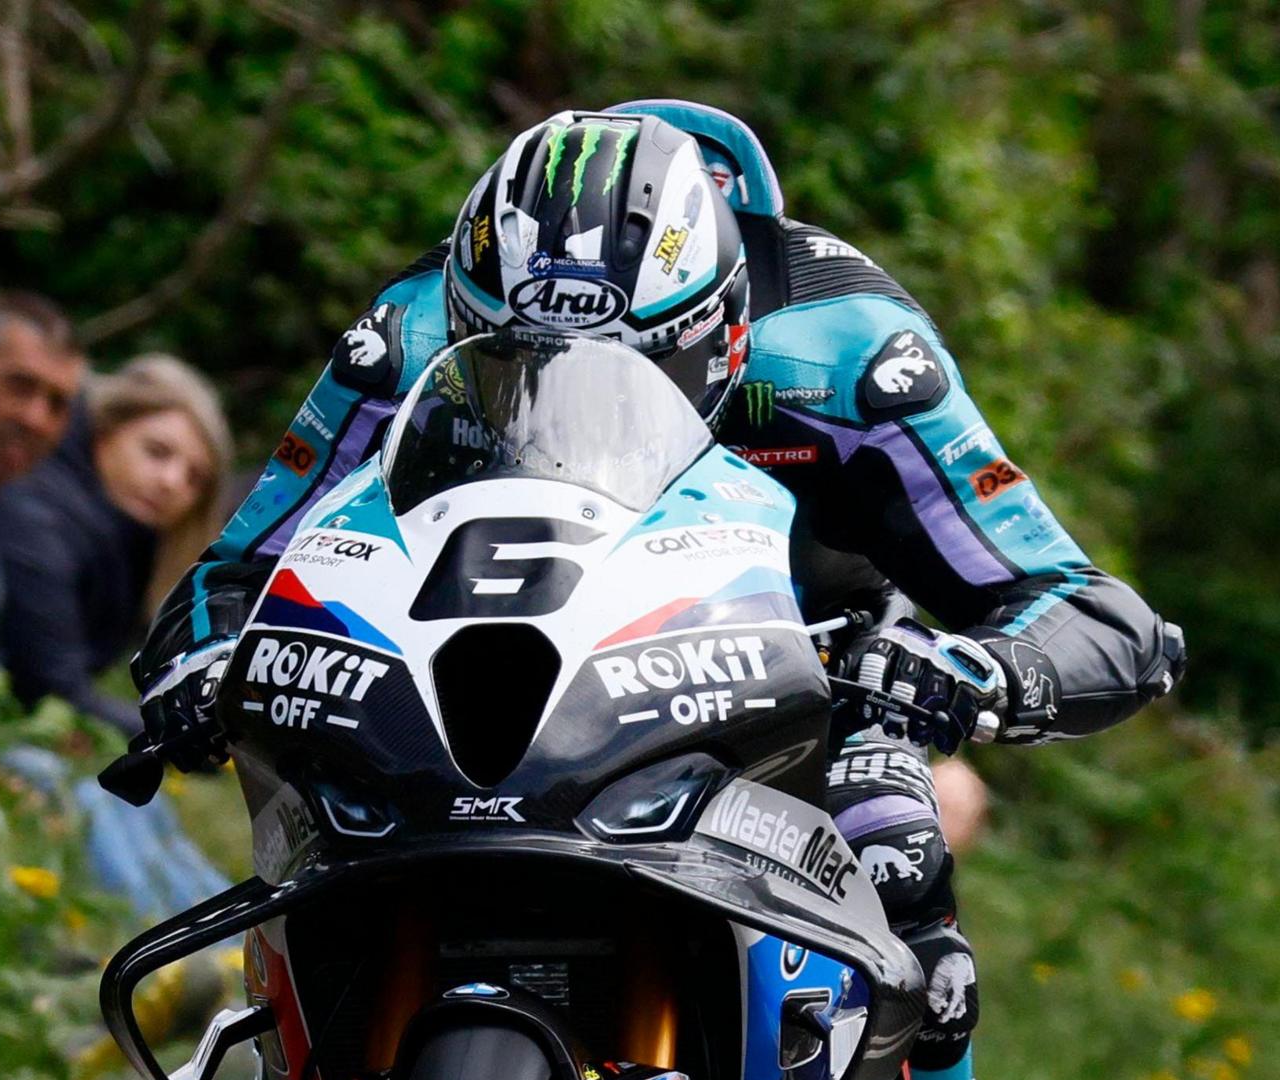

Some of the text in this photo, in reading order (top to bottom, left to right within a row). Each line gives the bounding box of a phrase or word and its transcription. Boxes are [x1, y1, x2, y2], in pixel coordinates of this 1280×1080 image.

[654, 226, 681, 261] TNC
[517, 280, 612, 316] Arai
[738, 450, 812, 462] ATTRO
[644, 529, 704, 556] carl
[408, 517, 608, 622] 6
[271, 694, 322, 730] OFF
[669, 690, 733, 726] OFF
[866, 690, 902, 712] domino
[450, 796, 527, 823] SMR
